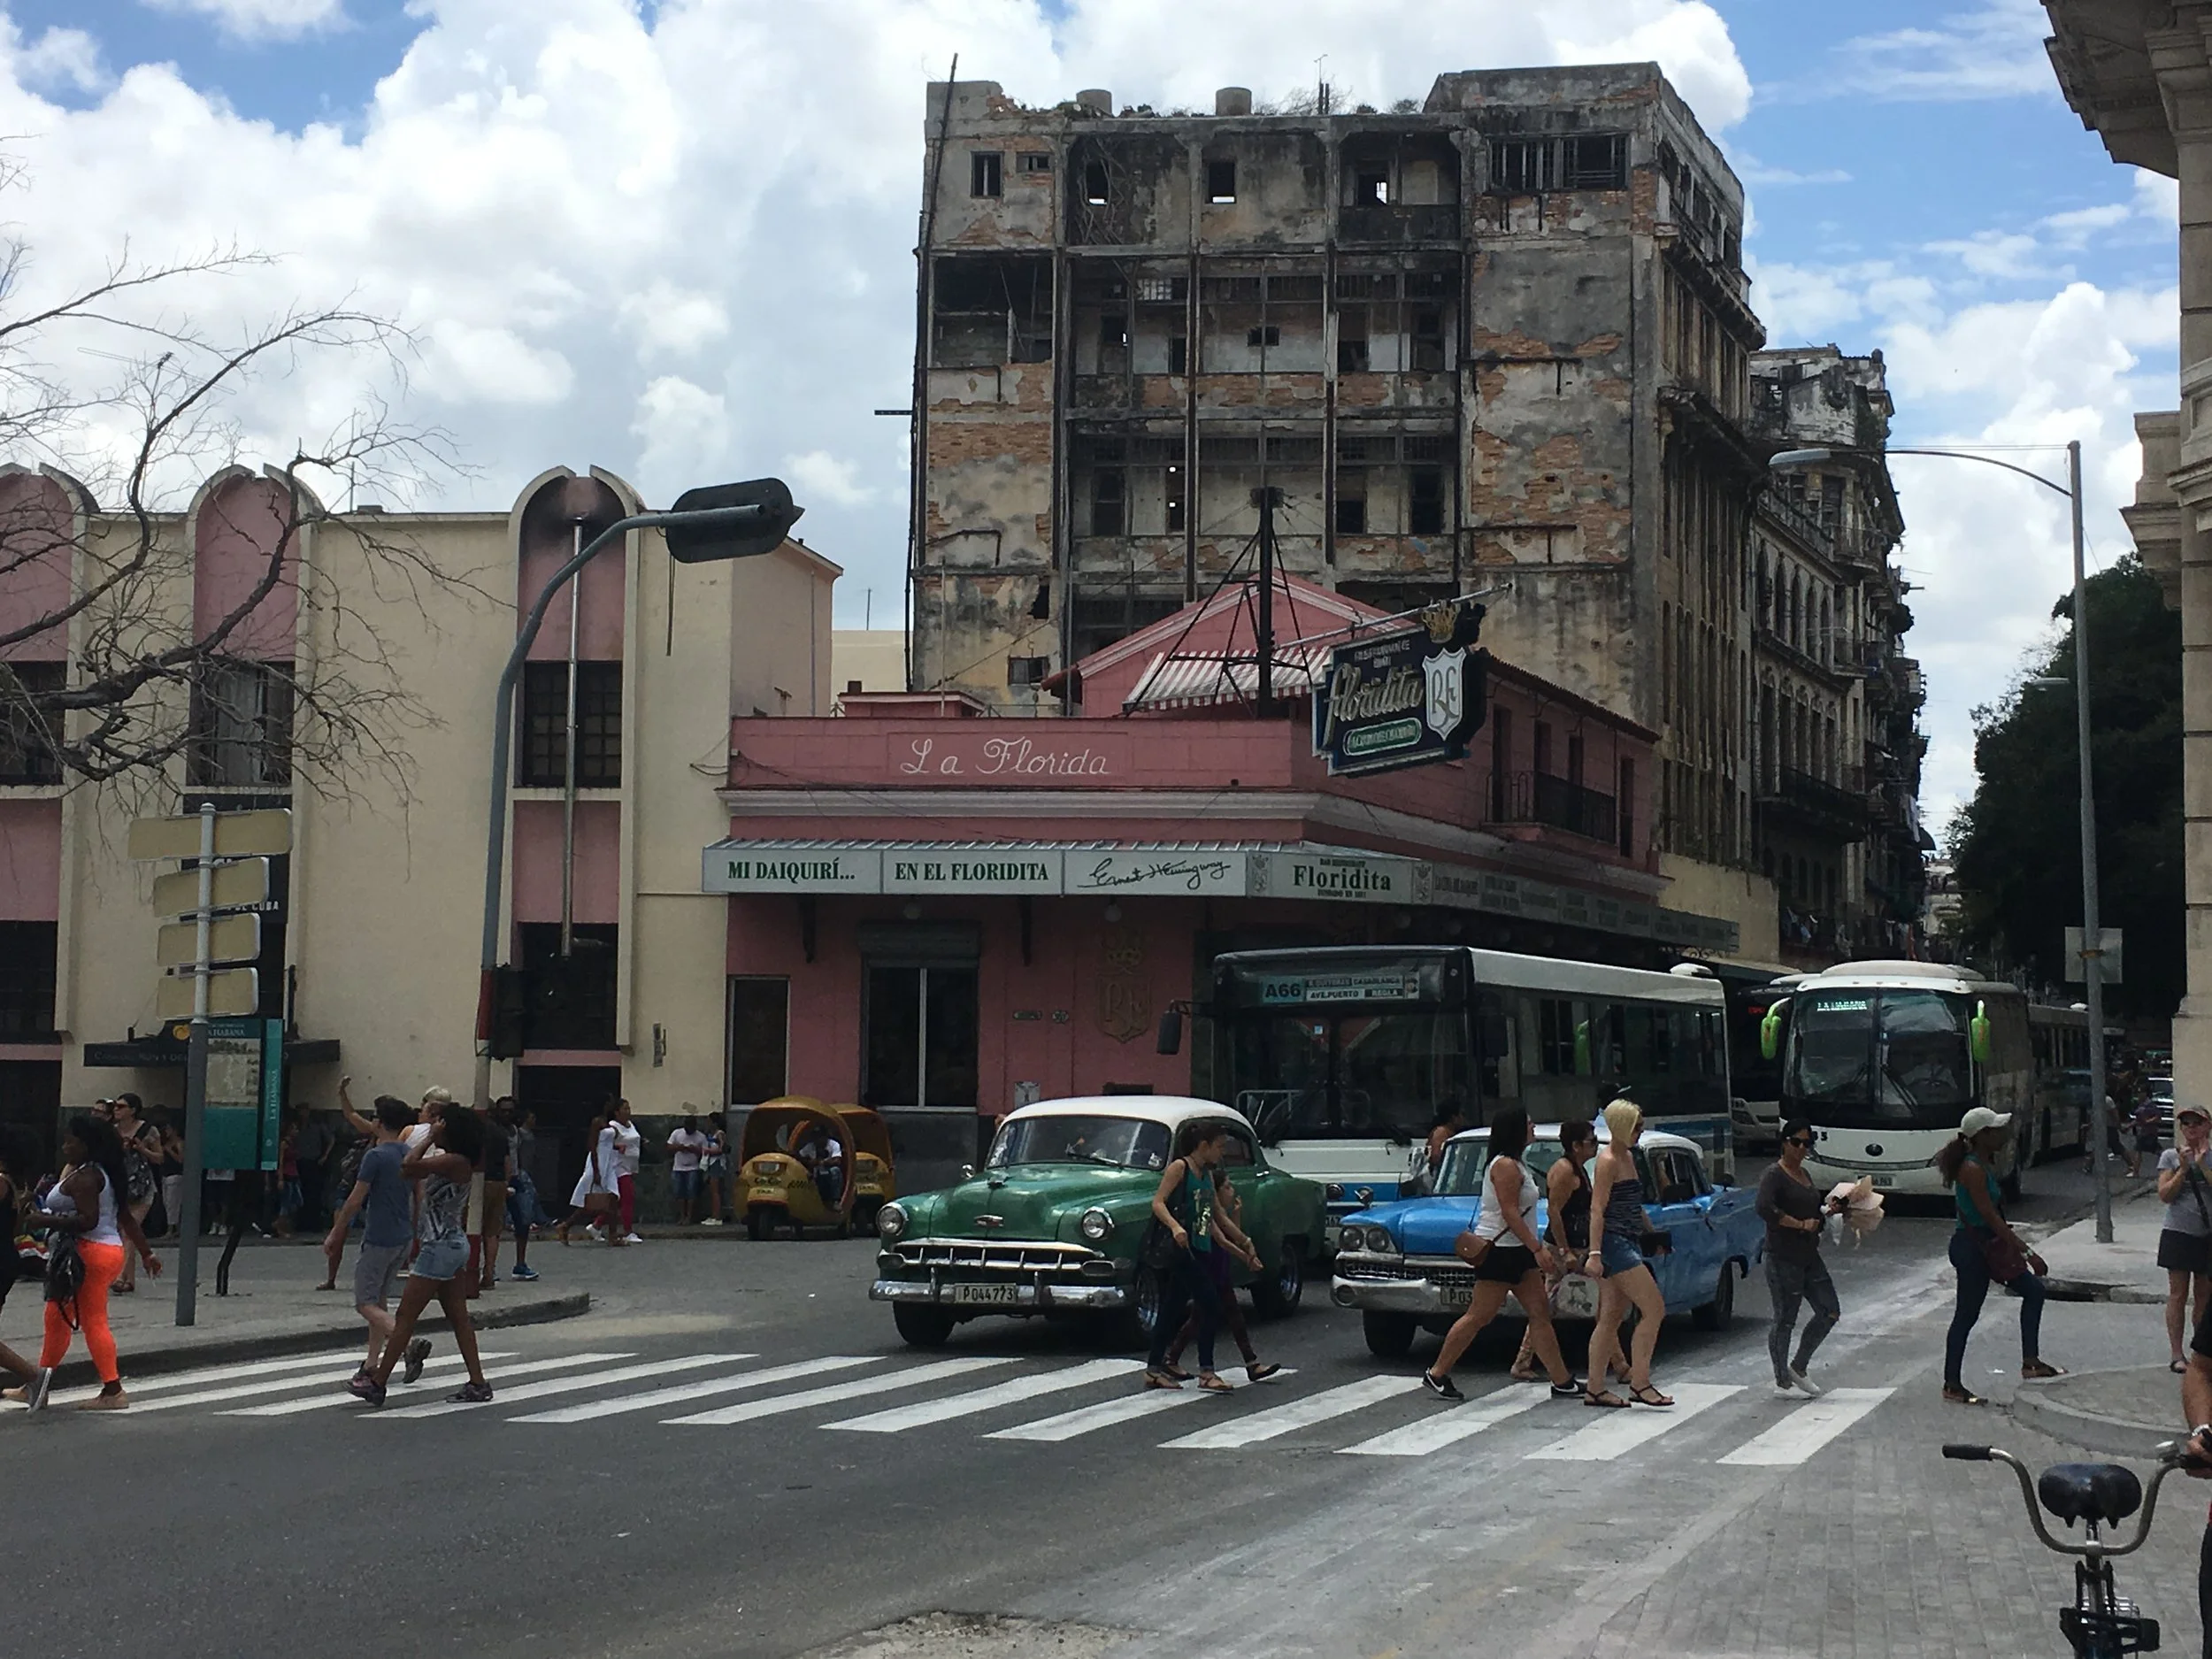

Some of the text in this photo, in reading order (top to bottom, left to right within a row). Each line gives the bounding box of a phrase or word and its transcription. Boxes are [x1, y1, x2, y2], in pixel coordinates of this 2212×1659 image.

[899, 736, 1110, 776] La Florida
[728, 861, 750, 880] MI
[895, 863, 1048, 881] EN EL FLORIDITA
[1293, 865, 1392, 891] Floridita
[1265, 983, 1301, 999] A66
